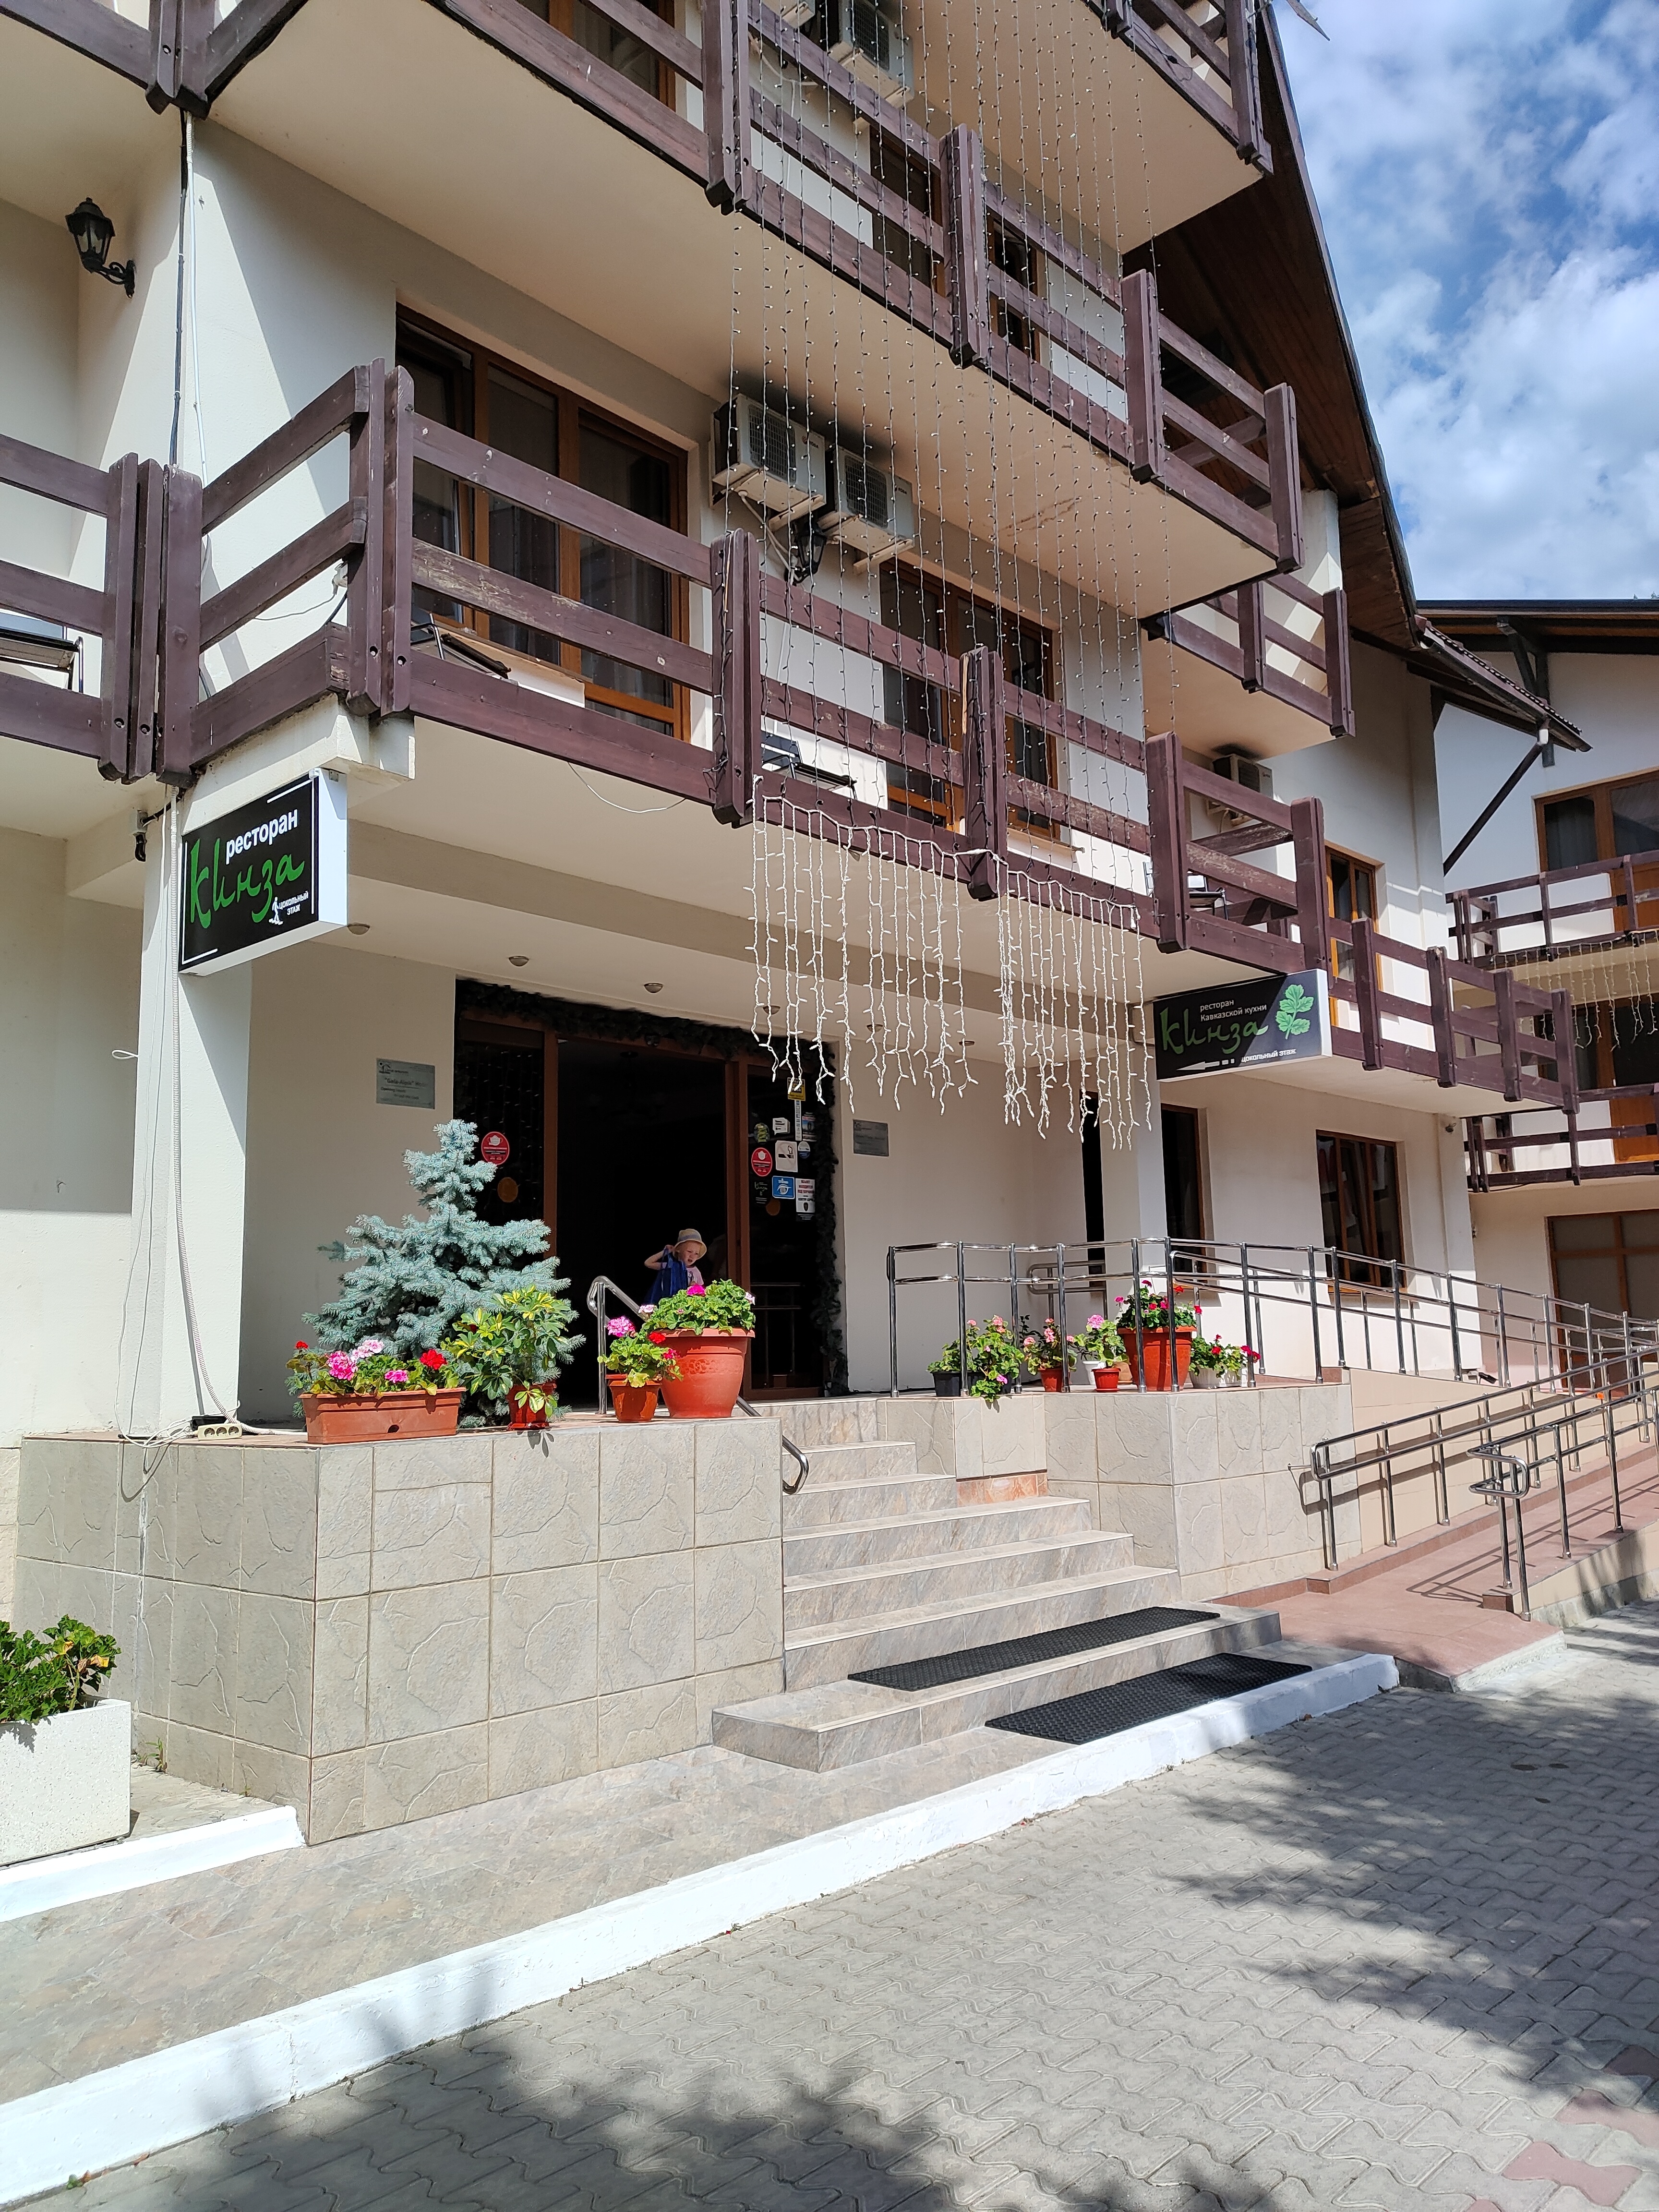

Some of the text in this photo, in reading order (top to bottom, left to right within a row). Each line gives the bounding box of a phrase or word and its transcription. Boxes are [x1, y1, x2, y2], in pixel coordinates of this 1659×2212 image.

[226, 809, 298, 865] ресторан
[1200, 1000, 1234, 1012] ресторан
[1201, 1004, 1267, 1022] Кавказской кухни
